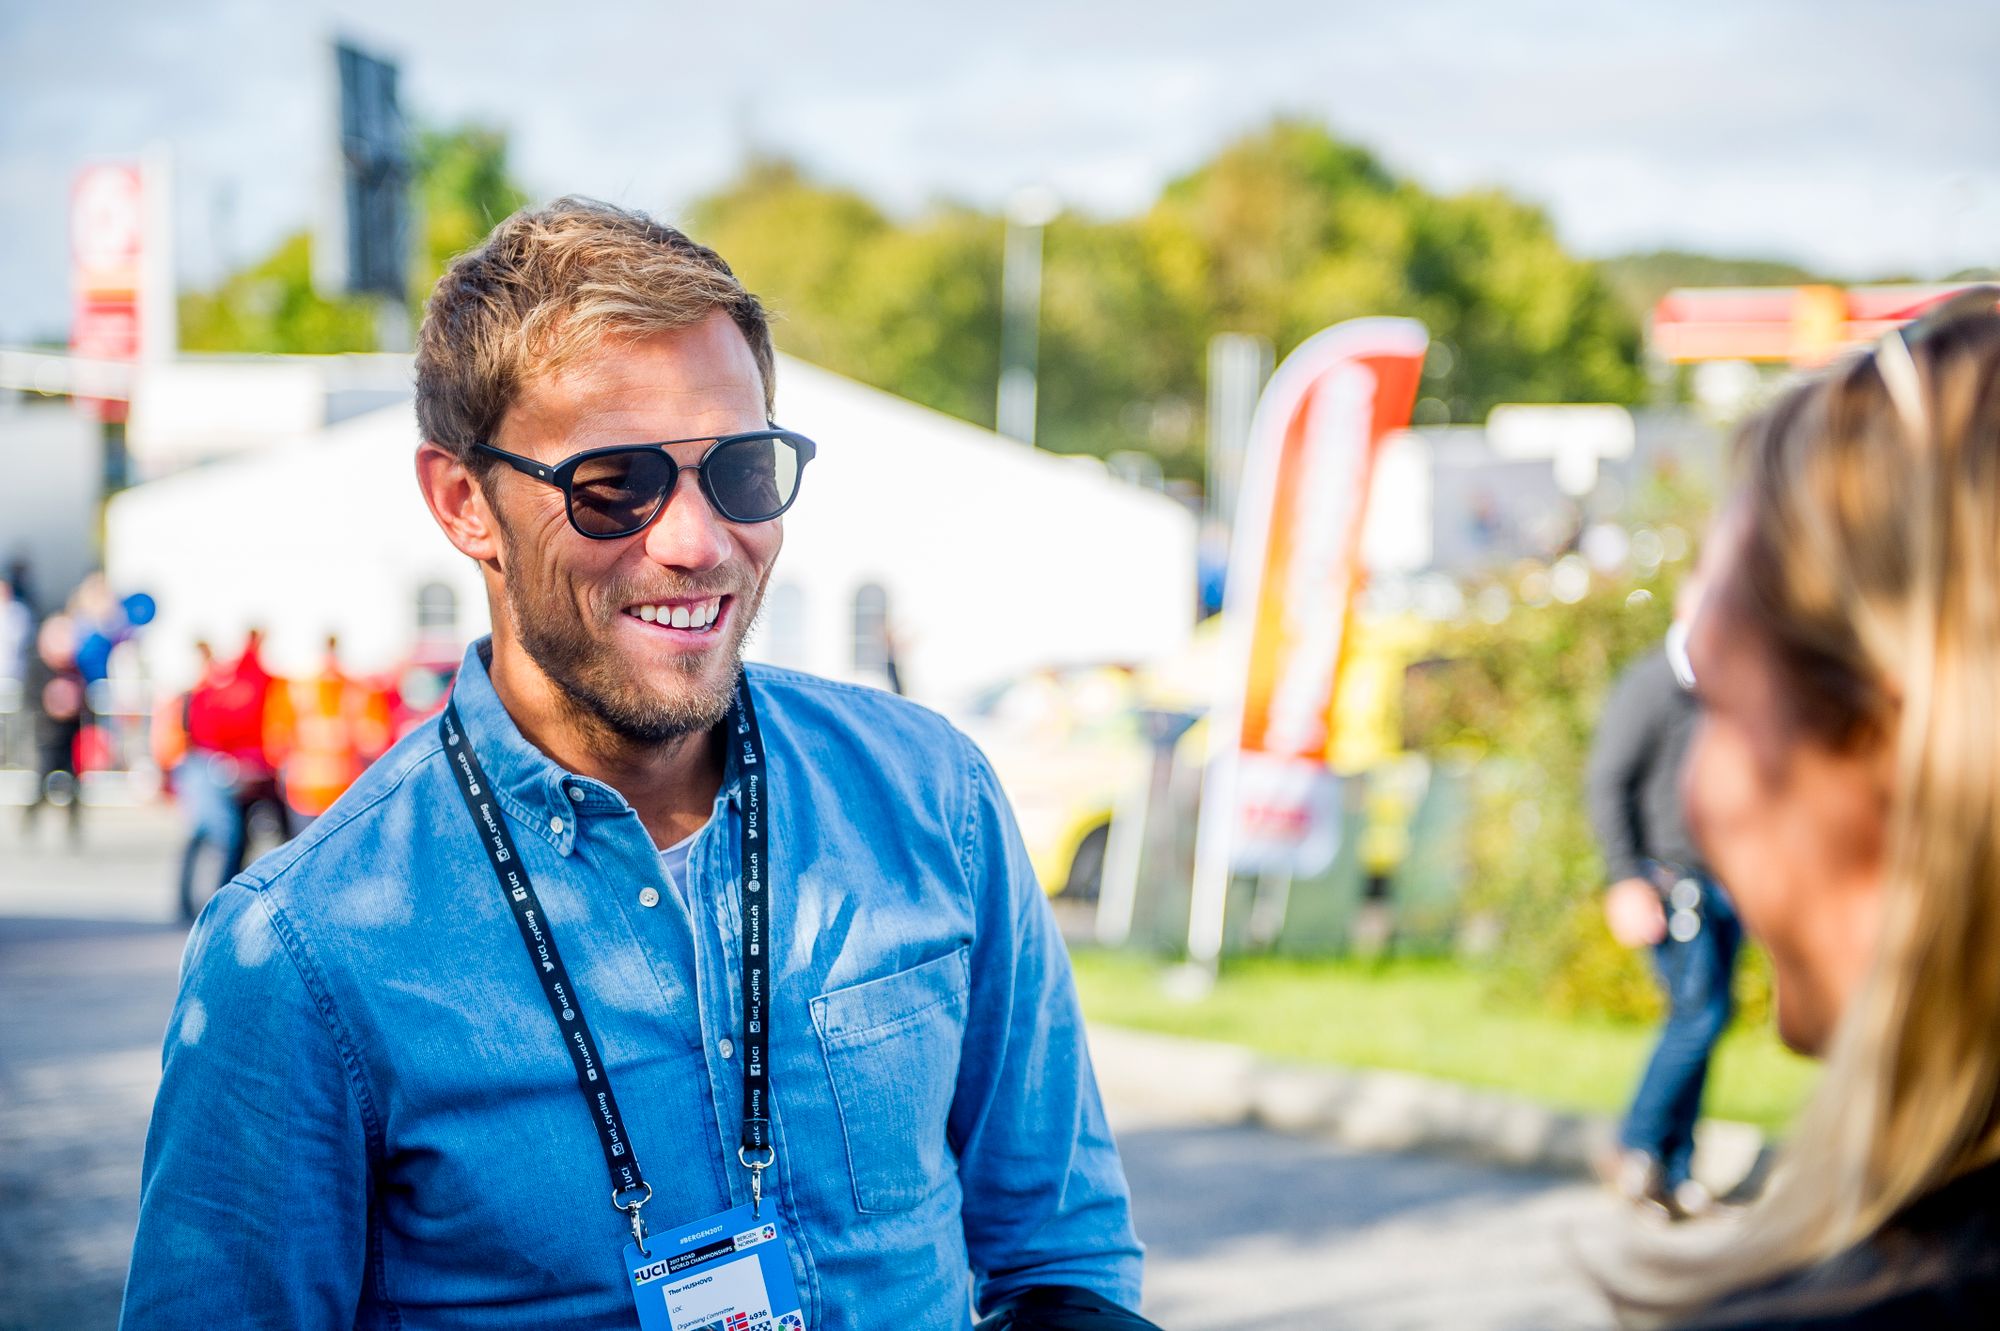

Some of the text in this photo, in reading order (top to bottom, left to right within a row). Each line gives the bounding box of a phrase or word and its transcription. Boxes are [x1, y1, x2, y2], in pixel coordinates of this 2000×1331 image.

[749, 775, 759, 828] UCI_cycling
[750, 852, 758, 880] uci.ch
[750, 904, 759, 943] tv.uci.ch
[525, 909, 550, 962] UCI_cycling
[553, 982, 570, 1009] uci.ch
[750, 968, 761, 1020] uci_cycling
[573, 1031, 593, 1069] tv.uci.ch
[751, 1046, 760, 1063] UCI
[597, 1092, 619, 1143] uci_cycling
[679, 1225, 723, 1245] #BERGEN2017
[736, 1231, 757, 1243] BERGEN
[738, 1237, 759, 1248] NORWAY
[670, 1245, 733, 1272] WORLD CHAMPIONSHIPS
[681, 1252, 695, 1263] ROAD
[640, 1263, 667, 1281] UCI
[668, 1276, 713, 1296] Thor HUSHOVD
[707, 1305, 735, 1320] Committee
[749, 1309, 768, 1321] 4936
